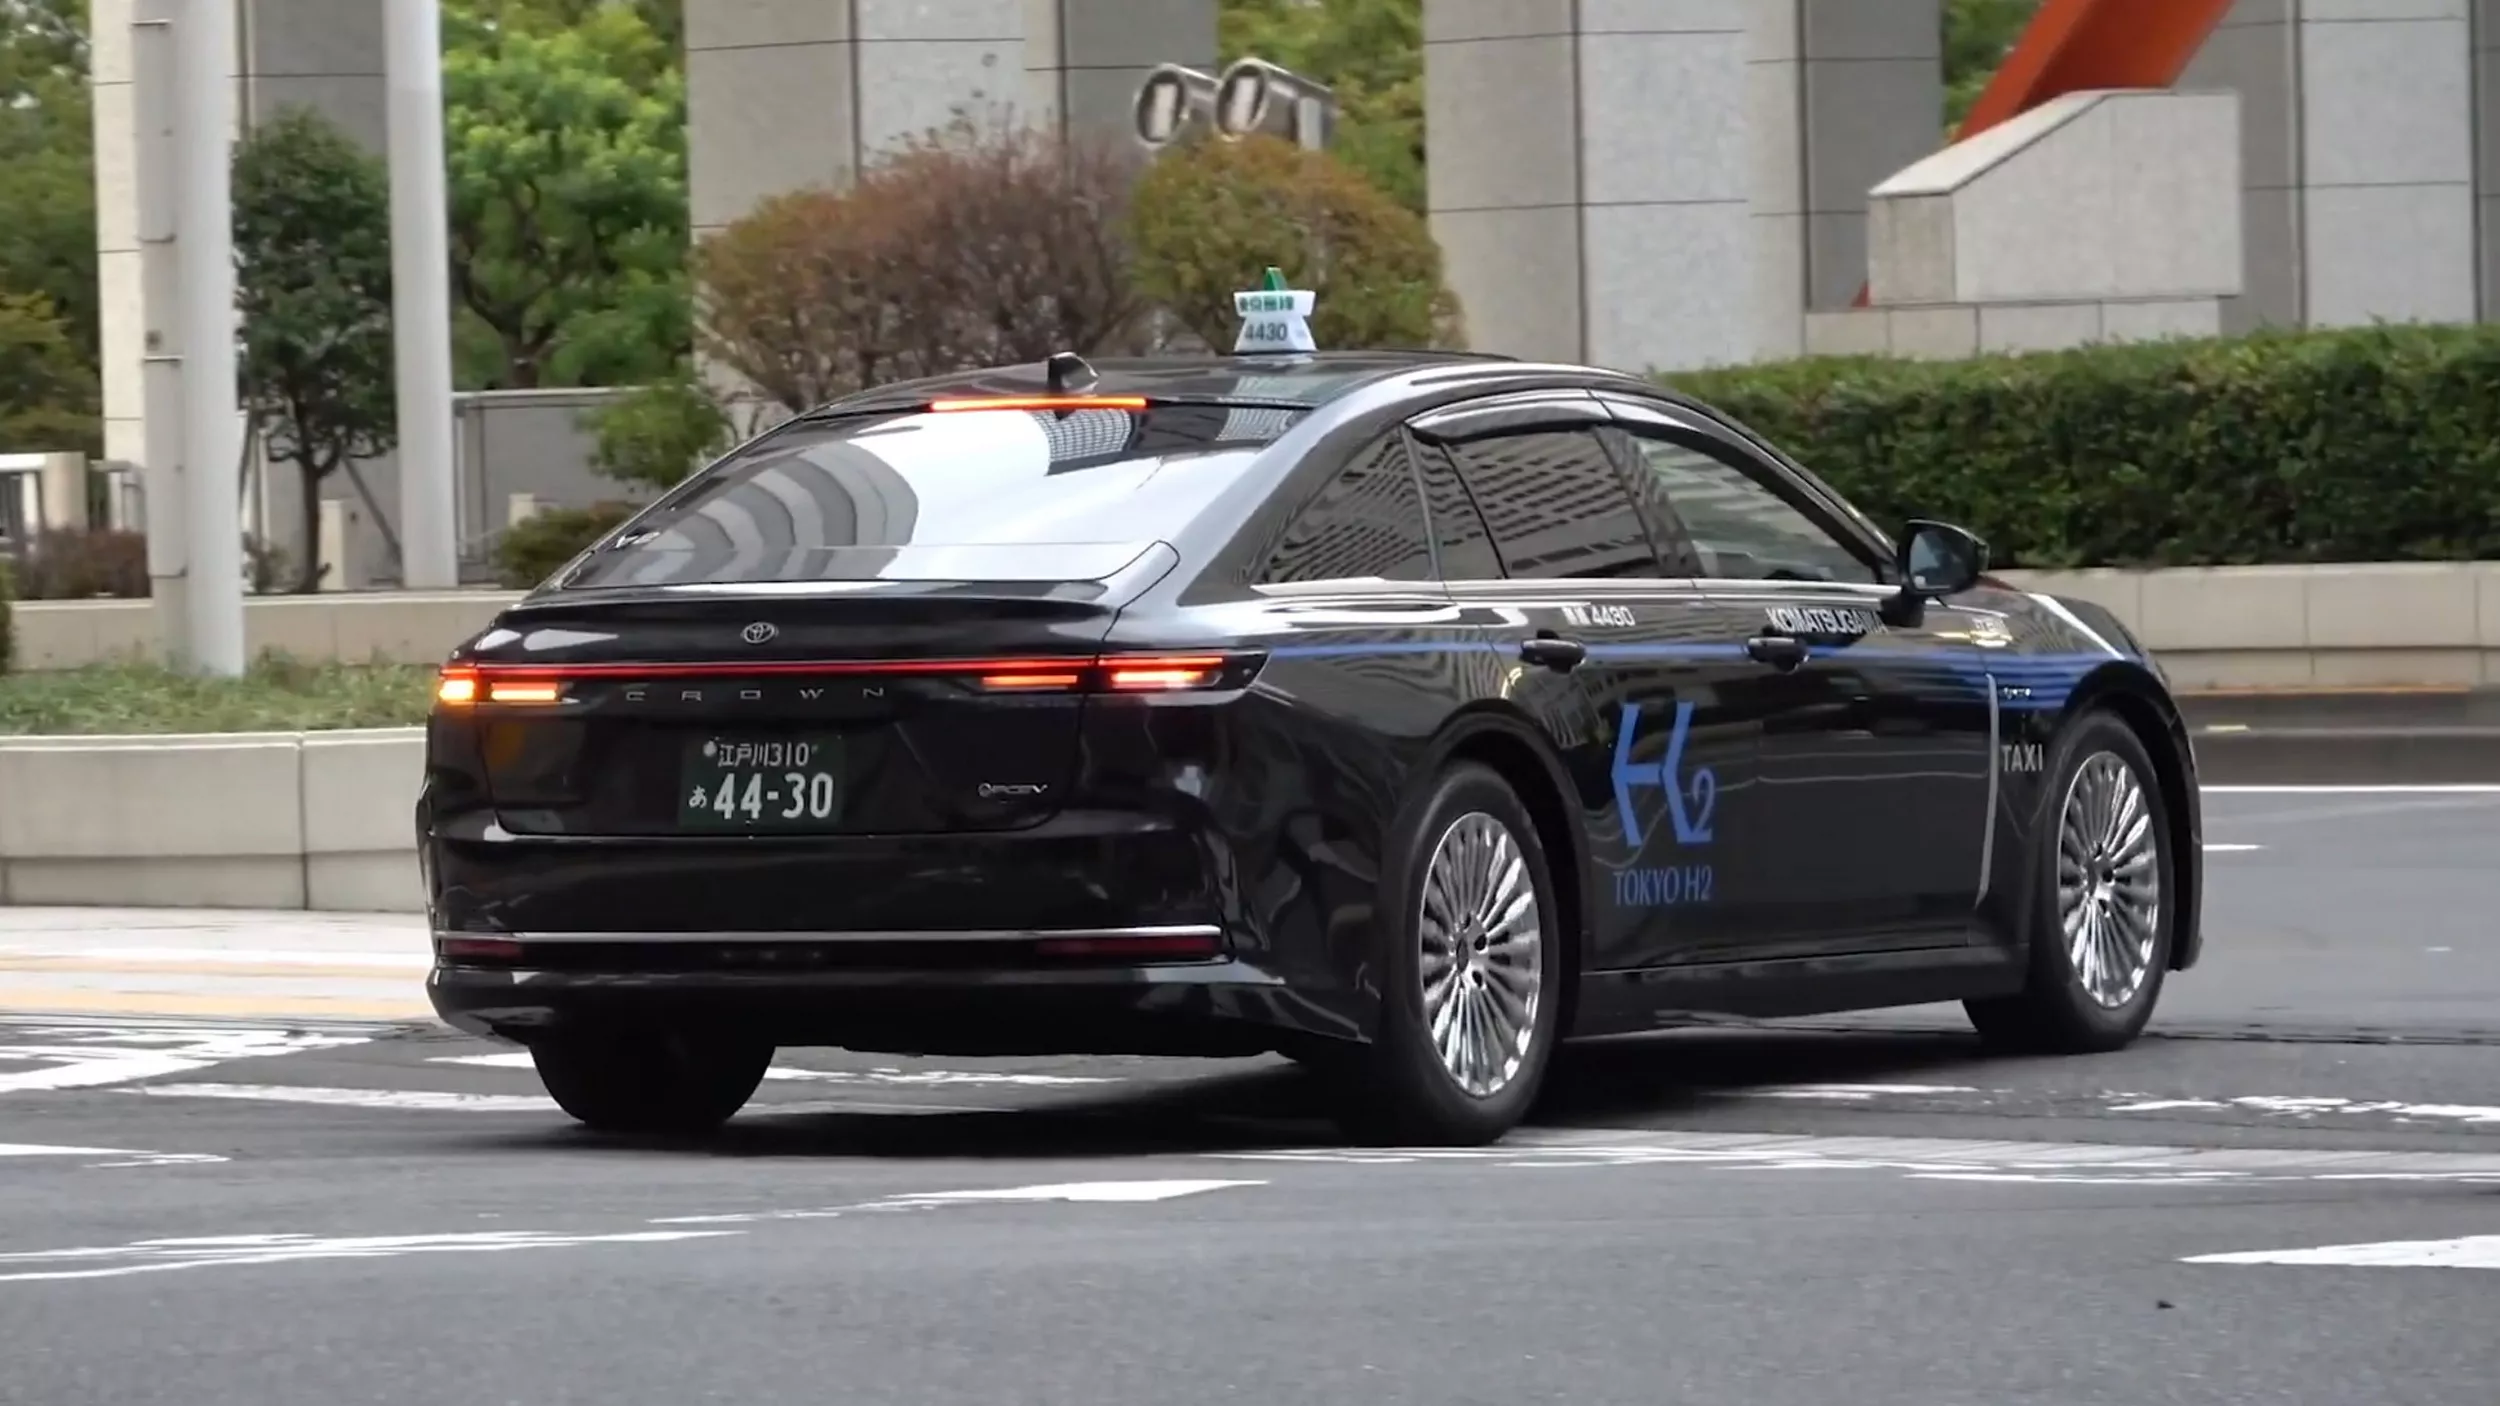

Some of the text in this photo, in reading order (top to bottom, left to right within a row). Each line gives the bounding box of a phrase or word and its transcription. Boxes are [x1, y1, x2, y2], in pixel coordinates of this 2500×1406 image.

[1244, 322, 1288, 341] 4430
[625, 687, 884, 701] CROWN
[2001, 743, 2044, 773] TAXI
[688, 772, 834, 820] あ 44-30
[1613, 864, 1713, 906] TOKYO H2
